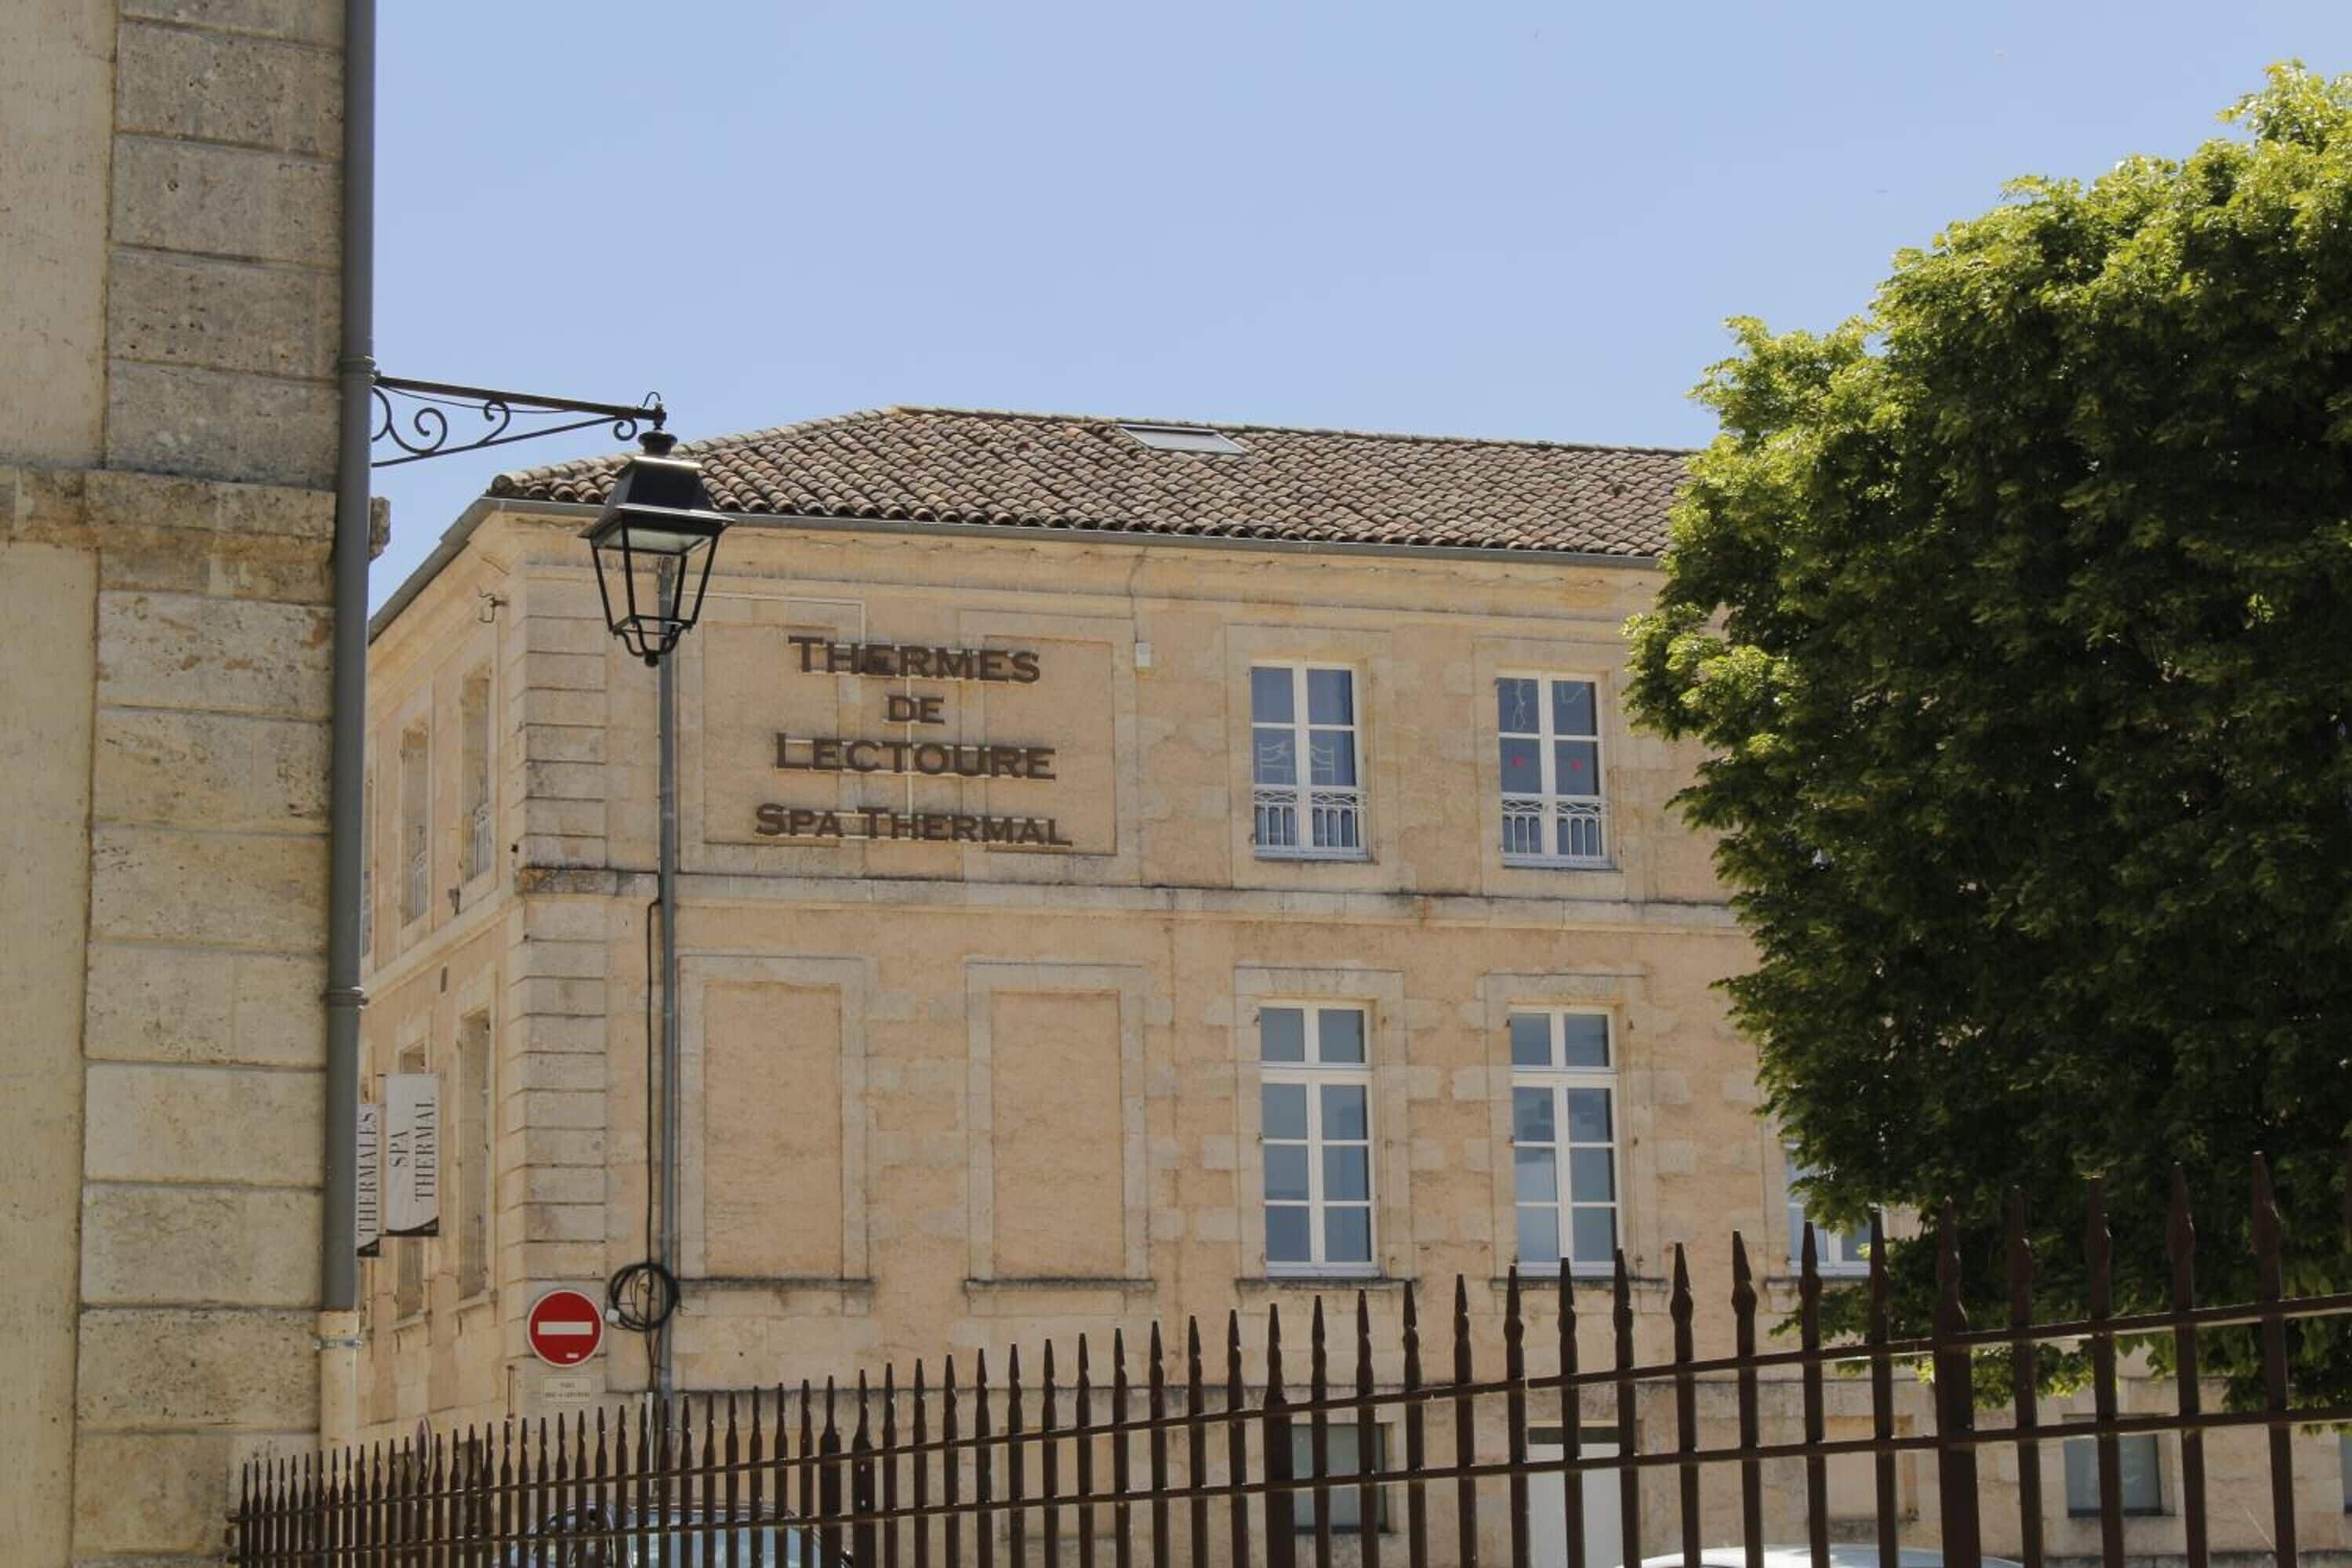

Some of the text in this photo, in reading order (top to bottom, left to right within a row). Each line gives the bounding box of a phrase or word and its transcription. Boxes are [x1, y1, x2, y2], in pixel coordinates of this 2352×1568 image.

[788, 635, 1040, 684] THERMES
[886, 695, 946, 724] DE
[775, 732, 1056, 781] LECTOURE
[754, 803, 1073, 846] SPA THERMAL
[388, 1131, 408, 1168] SPA
[414, 1098, 435, 1203] THERMAL
